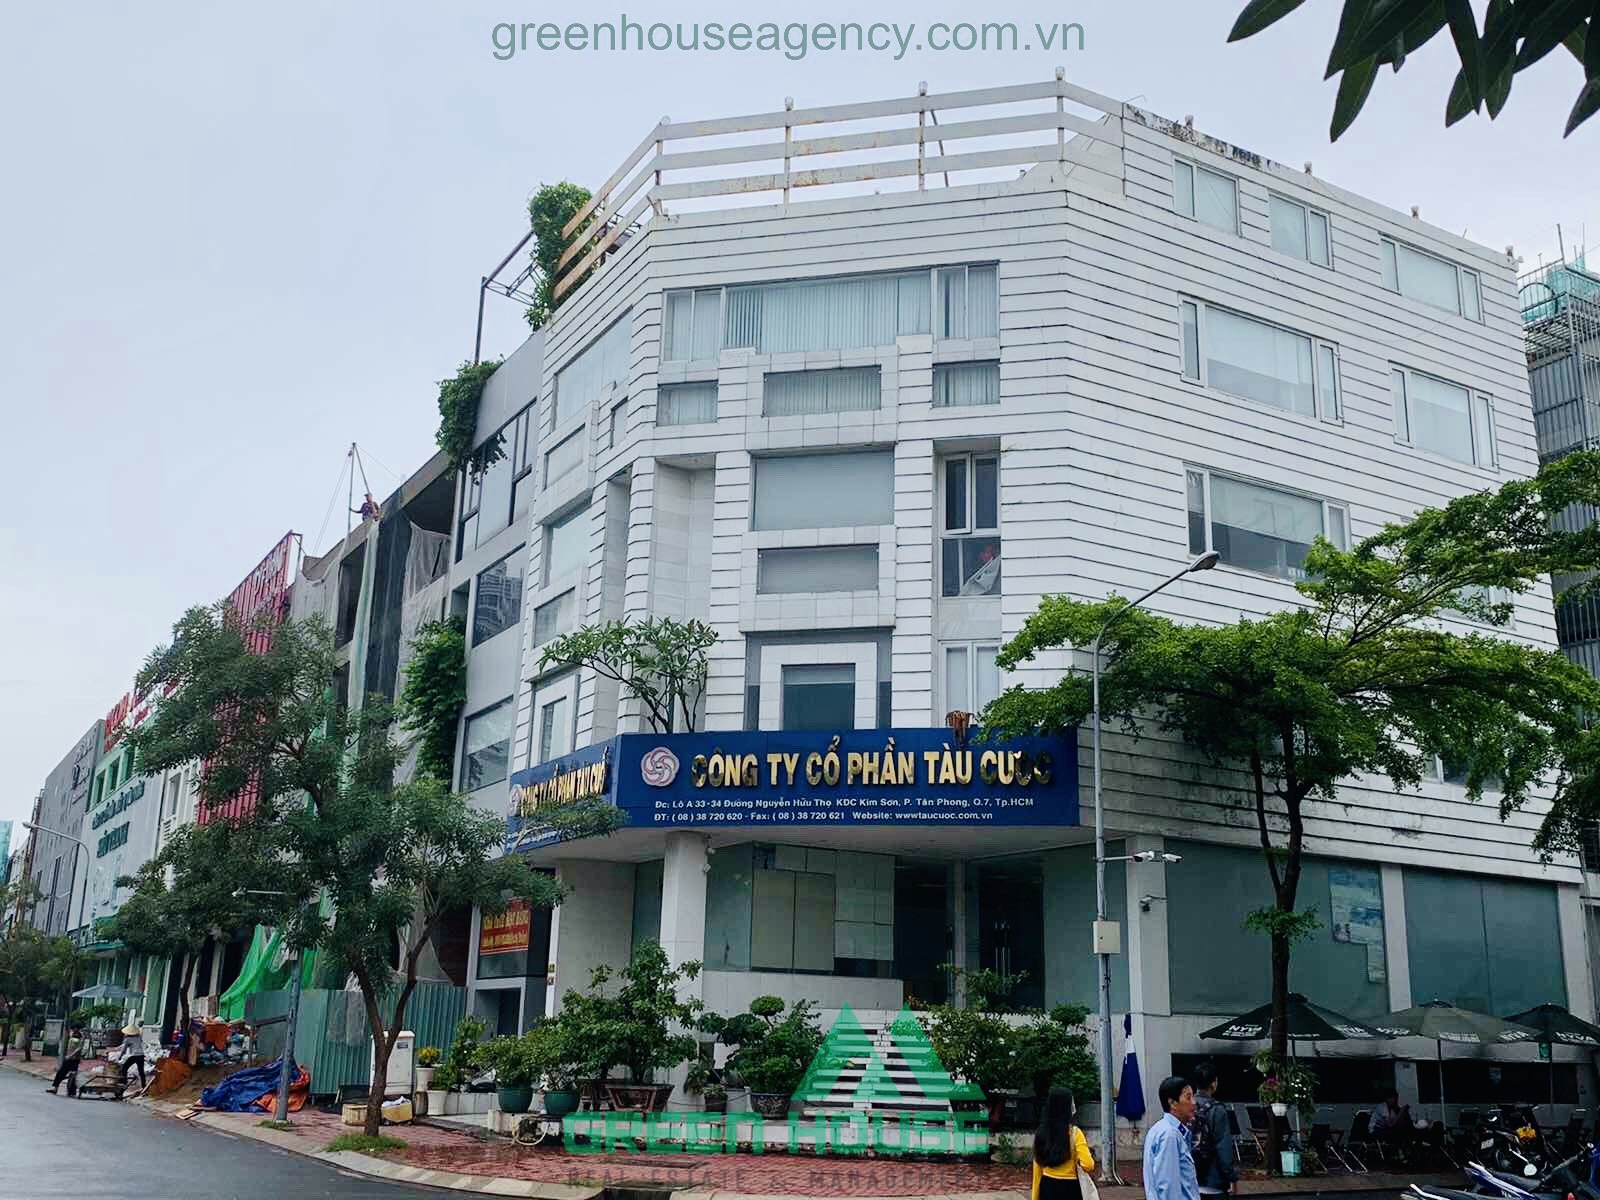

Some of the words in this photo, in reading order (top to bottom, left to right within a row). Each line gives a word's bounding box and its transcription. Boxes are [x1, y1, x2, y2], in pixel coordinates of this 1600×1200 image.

[691, 746, 758, 787] CÔNG
[766, 752, 799, 786] TY
[805, 735, 841, 786] CỔ
[847, 736, 915, 785] PHẦN
[924, 742, 973, 785] TÀU
[859, 798, 878, 807] Kim
[903, 798, 912, 807] P.
[995, 798, 1034, 809] Tp.HCM
[708, 812, 725, 821] 720
[726, 811, 743, 821] 620
[750, 811, 770, 821] Fax:
[809, 811, 827, 820] 720
[828, 811, 845, 820] 621
[852, 811, 893, 820] Website:
